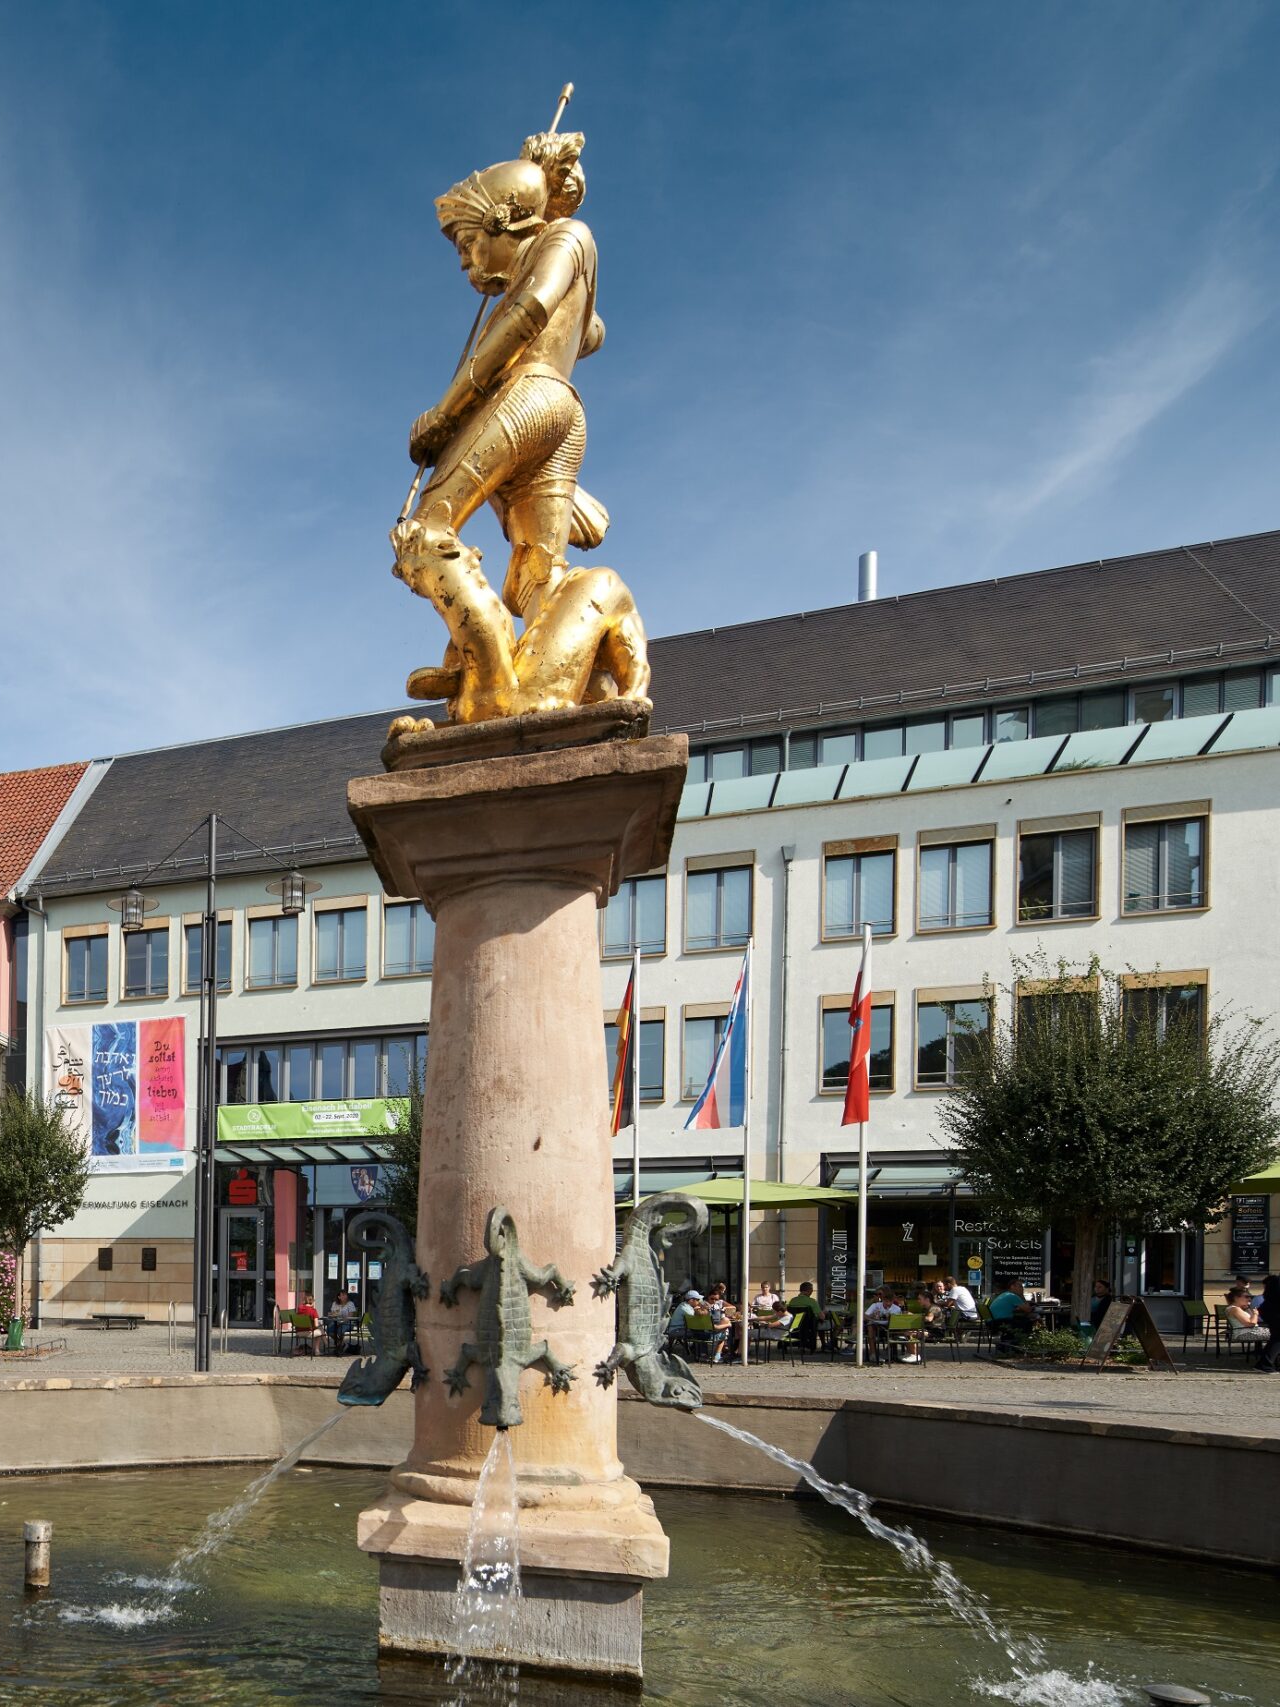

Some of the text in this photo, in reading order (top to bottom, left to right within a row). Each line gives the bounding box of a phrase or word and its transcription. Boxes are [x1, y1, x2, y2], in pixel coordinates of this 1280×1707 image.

[154, 1041, 170, 1052] Du
[148, 1052, 176, 1063] sollst
[147, 1085, 177, 1099] lieben
[141, 1200, 188, 1208] EISENACH
[954, 1219, 1042, 1233] Resta
[831, 1229, 847, 1300] ZUCKER & ZIMT
